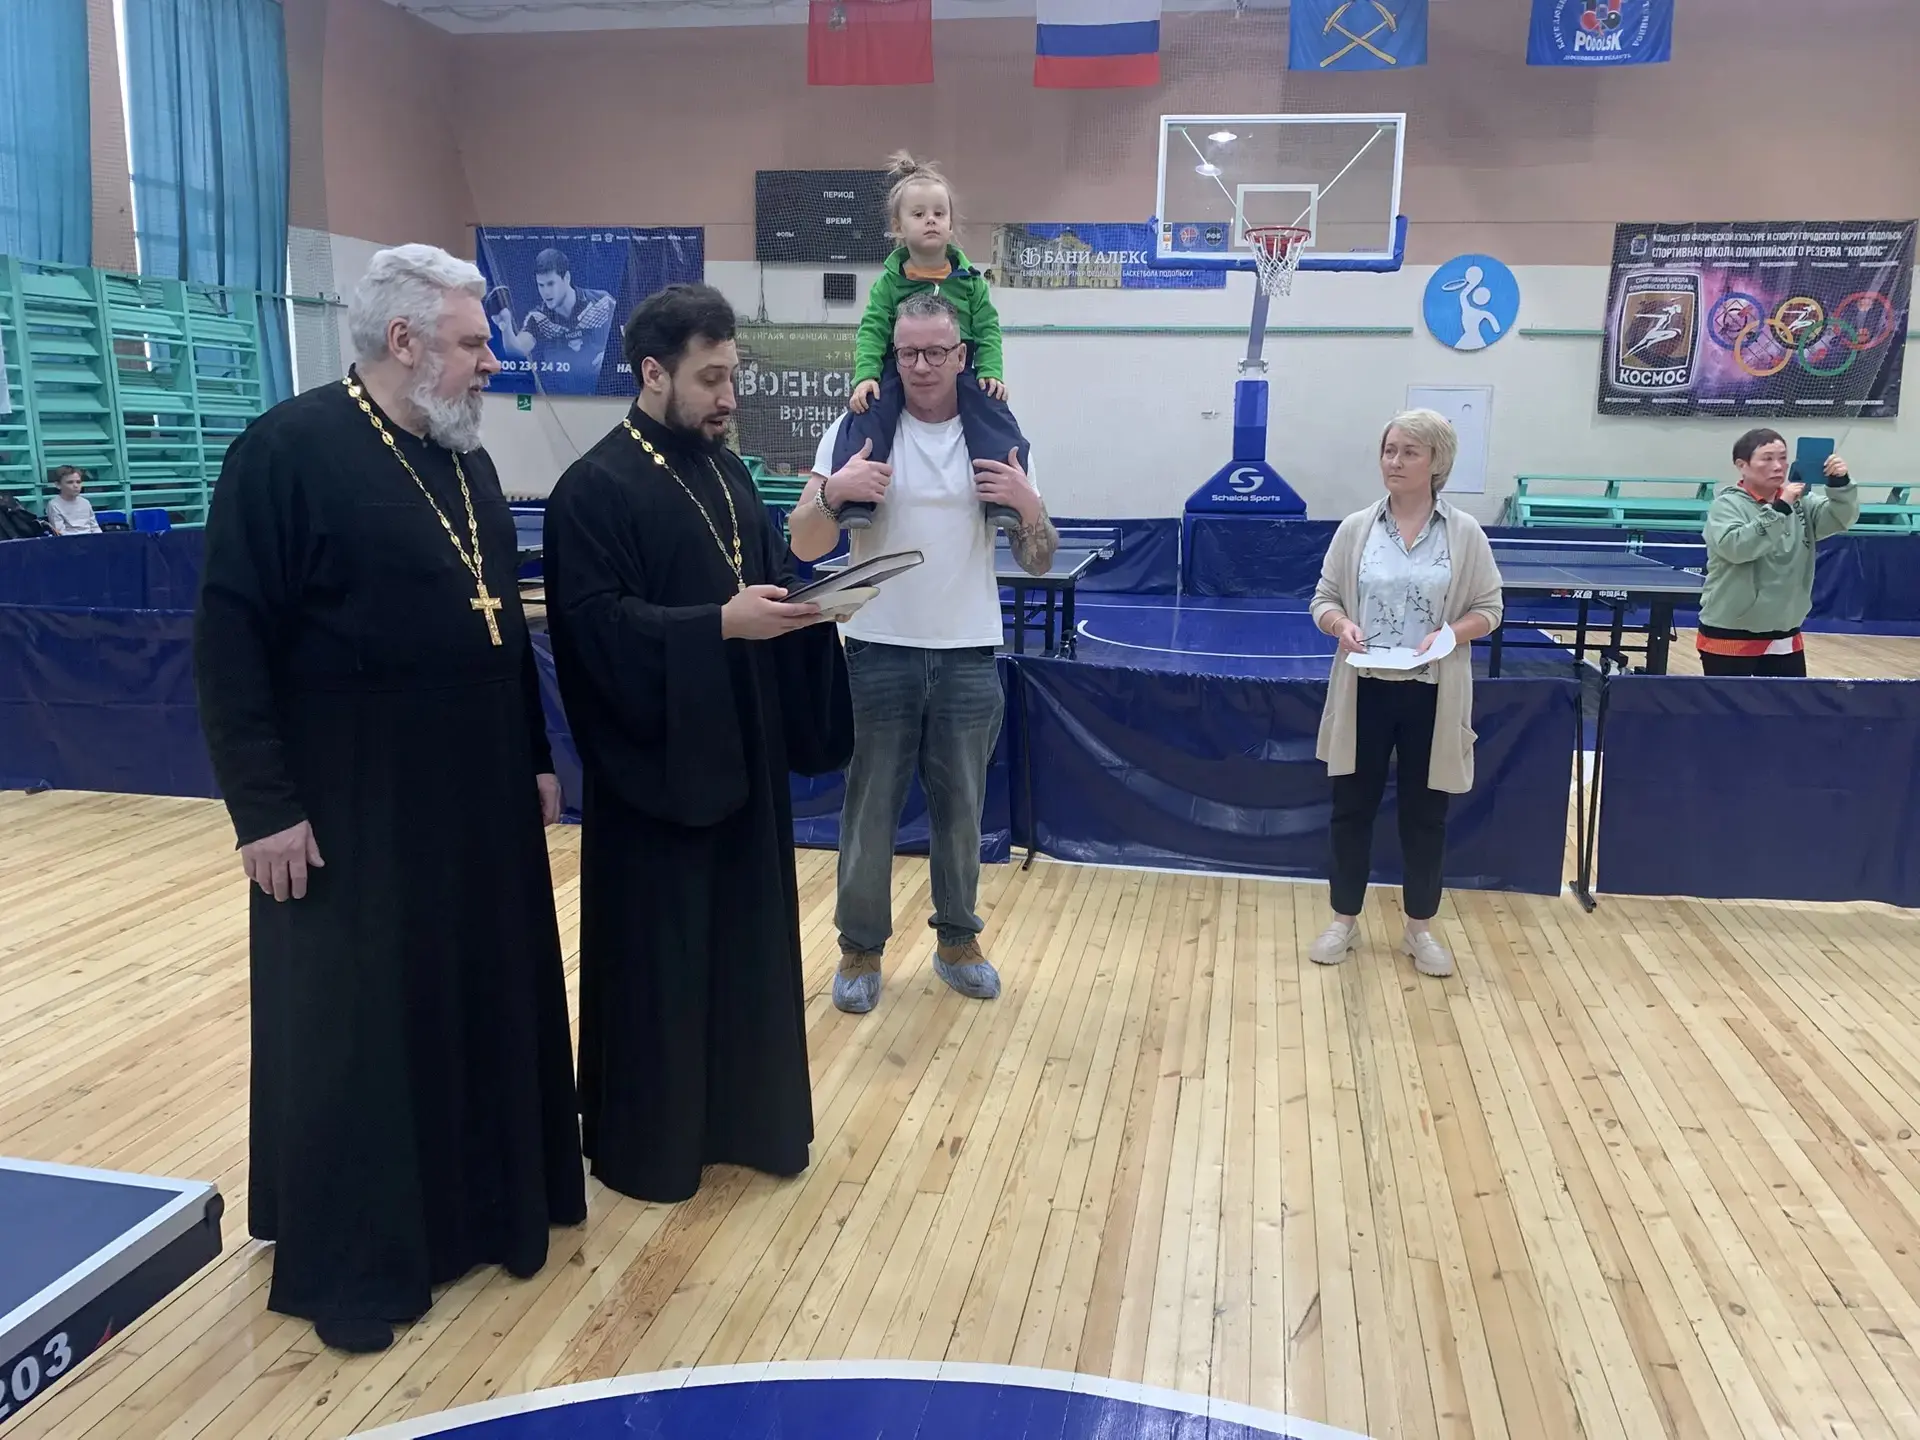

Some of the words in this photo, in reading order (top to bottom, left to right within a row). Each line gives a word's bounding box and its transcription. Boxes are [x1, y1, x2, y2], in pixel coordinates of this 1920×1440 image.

[1574, 28, 1623, 52] PODOLSK
[823, 191, 854, 199] ПЕРИОД
[826, 217, 852, 225] ВРЕМЯ
[1691, 231, 1733, 241] ФИЗИЧЕСКОЙ
[1735, 231, 1766, 241] КУЛЬТУРЕ
[1773, 232, 1798, 241] СПОРТУ
[1799, 232, 1840, 241] ГОРОДСКОГО
[1841, 231, 1866, 240] ОКРУГА
[1652, 247, 1702, 258] СПОРТИВНАЯ
[1704, 246, 1734, 257] ШКОЛА
[1735, 245, 1804, 257] ОЛИМПИЙСКОГО
[1805, 246, 1842, 257] РЕЗЕРВА
[1043, 251, 1091, 264] БАНИ
[1160, 270, 1194, 278] ПОДОЛЬСКА
[501, 360, 516, 371] 00
[519, 361, 537, 371] 234
[540, 362, 553, 372] 24
[556, 362, 570, 372] 20
[1620, 369, 1686, 384] КОСМОС
[780, 405, 848, 421] ВОЕНН
[1211, 494, 1249, 502] Schelde
[1250, 494, 1280, 503] Sports
[1572, 589, 1593, 599] 双鱼
